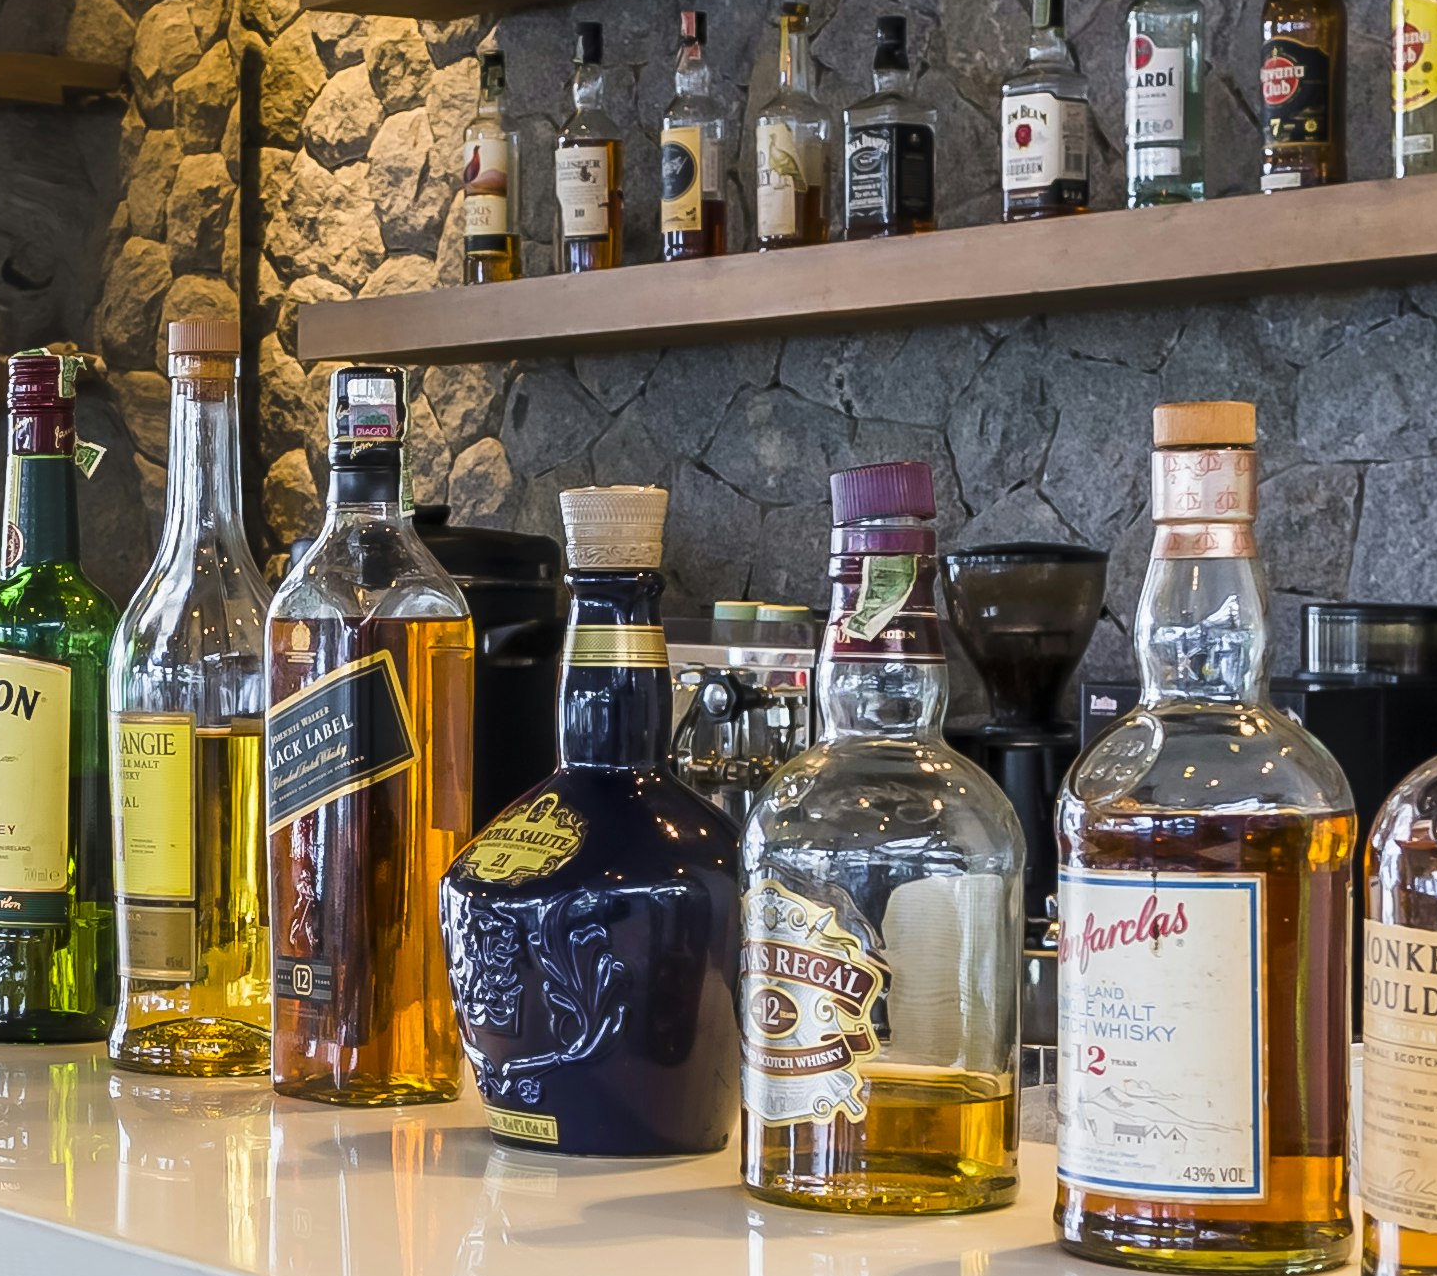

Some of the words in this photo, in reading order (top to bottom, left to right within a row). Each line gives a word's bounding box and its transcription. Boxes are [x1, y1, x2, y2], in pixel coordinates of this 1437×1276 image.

[1134, 67, 1174, 87] ARDÍ
[1270, 118, 1281, 136] 7
[355, 427, 389, 436] DIAGEO
[269, 724, 300, 749] JOHNNIE
[300, 706, 330, 727] WALKER
[267, 739, 303, 772] LACK
[305, 713, 354, 749] LABEL
[134, 760, 160, 769] MALT
[122, 771, 141, 780] ISKY
[517, 829, 574, 851] SALUTE
[490, 852, 513, 868] 21
[1059, 894, 1189, 974] lenfarclas
[296, 970, 309, 989] 12
[740, 944, 771, 973] IVAS
[774, 947, 864, 999] REGAL
[760, 996, 780, 1026] 12
[1100, 1003, 1156, 1022] MALT
[1093, 1022, 1177, 1043] WHISKY
[756, 1054, 794, 1069] SCOTCH
[795, 1046, 845, 1069] WHISKY
[1072, 1043, 1107, 1076] 12
[1182, 1166, 1216, 1183] 43%
[1219, 1166, 1247, 1183] VOL
